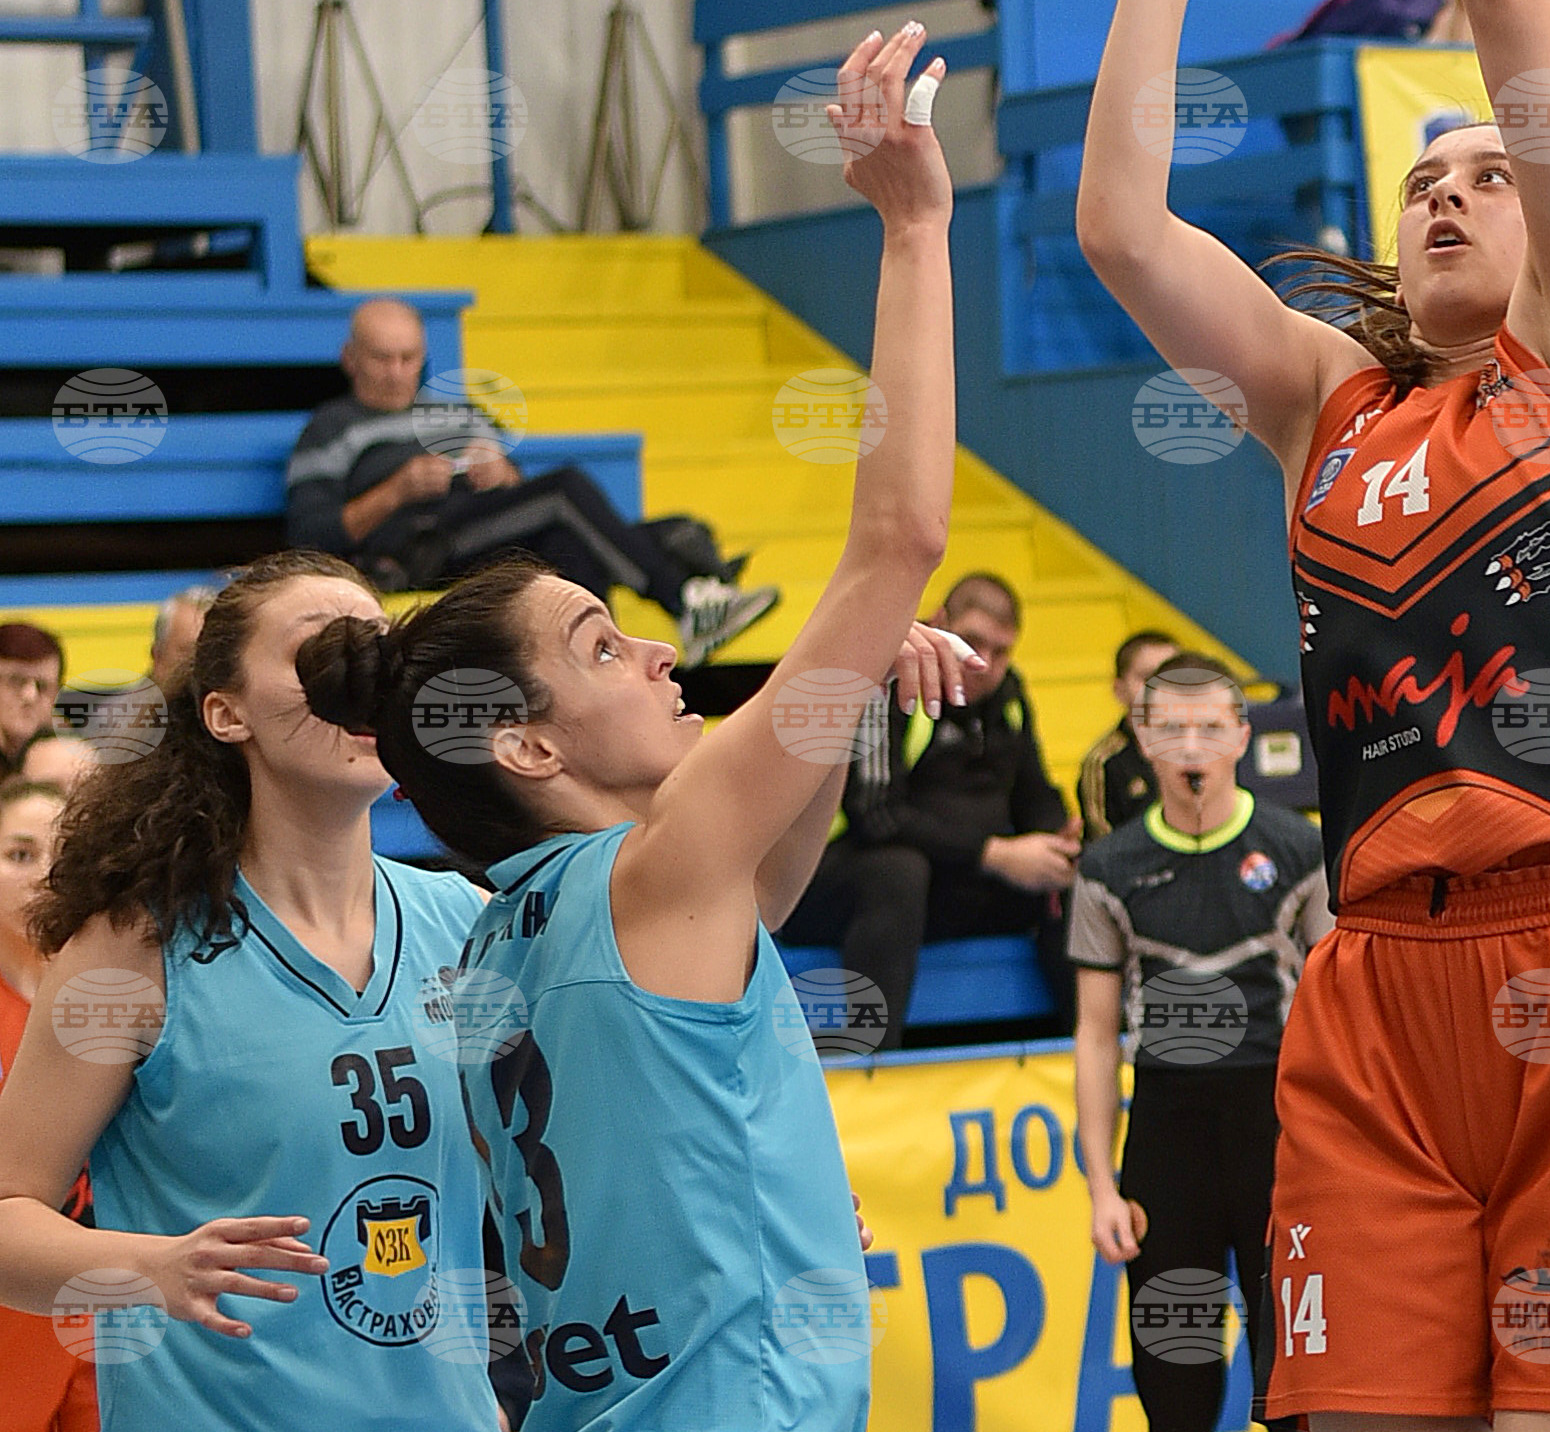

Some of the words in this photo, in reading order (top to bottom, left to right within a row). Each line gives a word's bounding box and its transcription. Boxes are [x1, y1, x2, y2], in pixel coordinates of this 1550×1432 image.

[1357, 437, 1431, 527] 14
[1362, 738, 1390, 762] HAIR
[1389, 726, 1422, 752] STUDIO
[330, 1045, 431, 1157] 35
[330, 1262, 439, 1338] ЗАСТРАХОВА
[1280, 1273, 1329, 1358] 14
